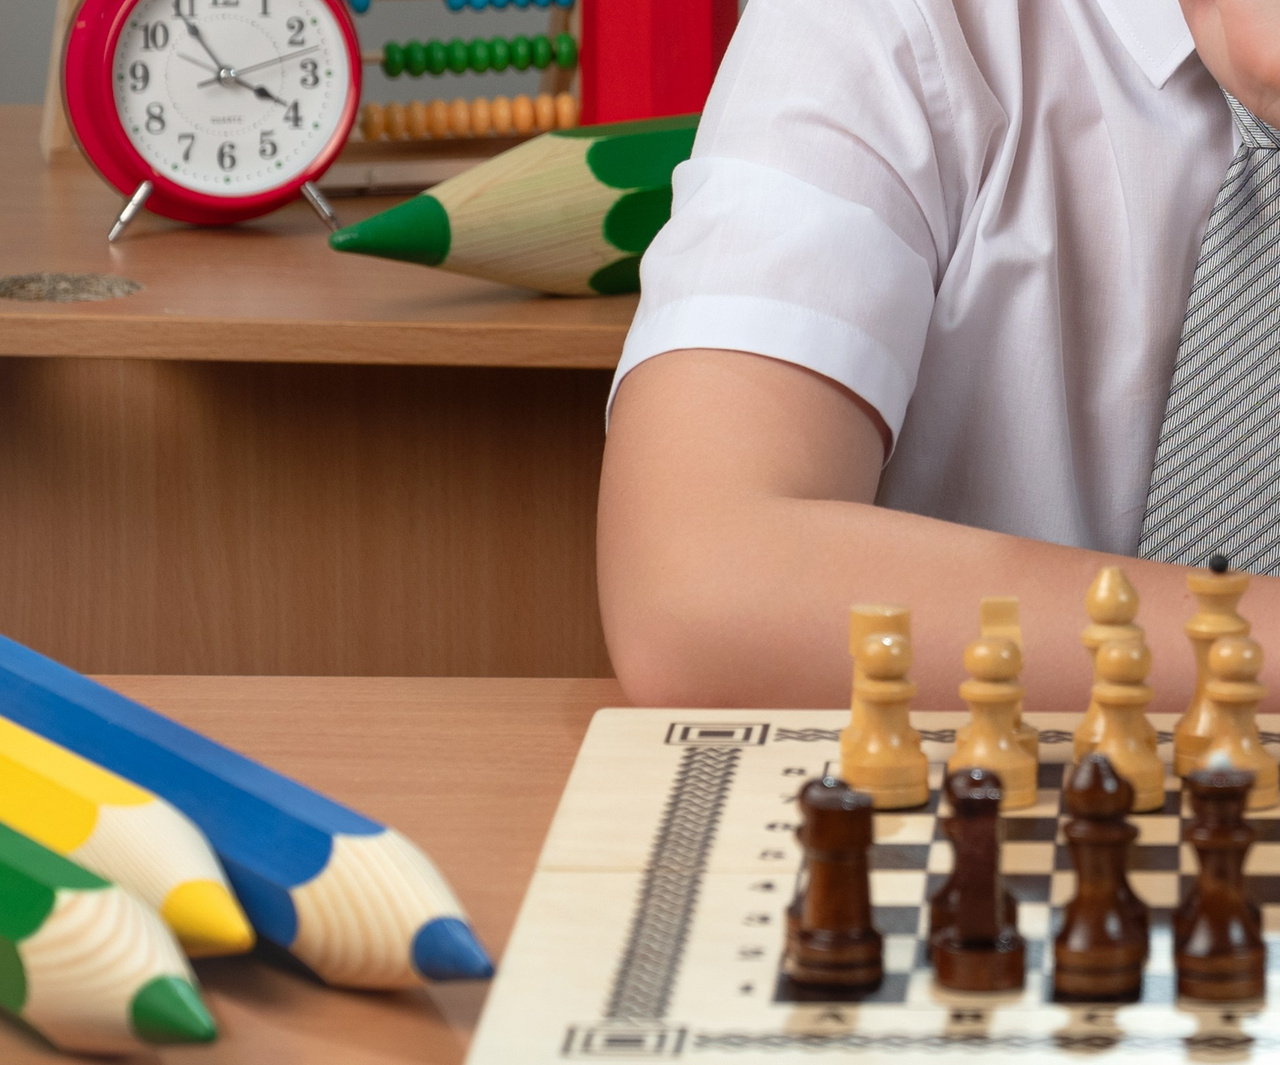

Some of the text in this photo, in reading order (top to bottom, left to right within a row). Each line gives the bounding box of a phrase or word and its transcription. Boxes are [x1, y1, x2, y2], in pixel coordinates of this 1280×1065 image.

[141, 20, 169, 51] 10
[286, 15, 305, 47] 2
[129, 60, 150, 93] 9
[300, 57, 320, 89] 3
[145, 101, 166, 135] 8
[283, 98, 303, 130] 4
[178, 132, 195, 163] 7
[217, 140, 236, 172] 6
[259, 129, 277, 159] 5
